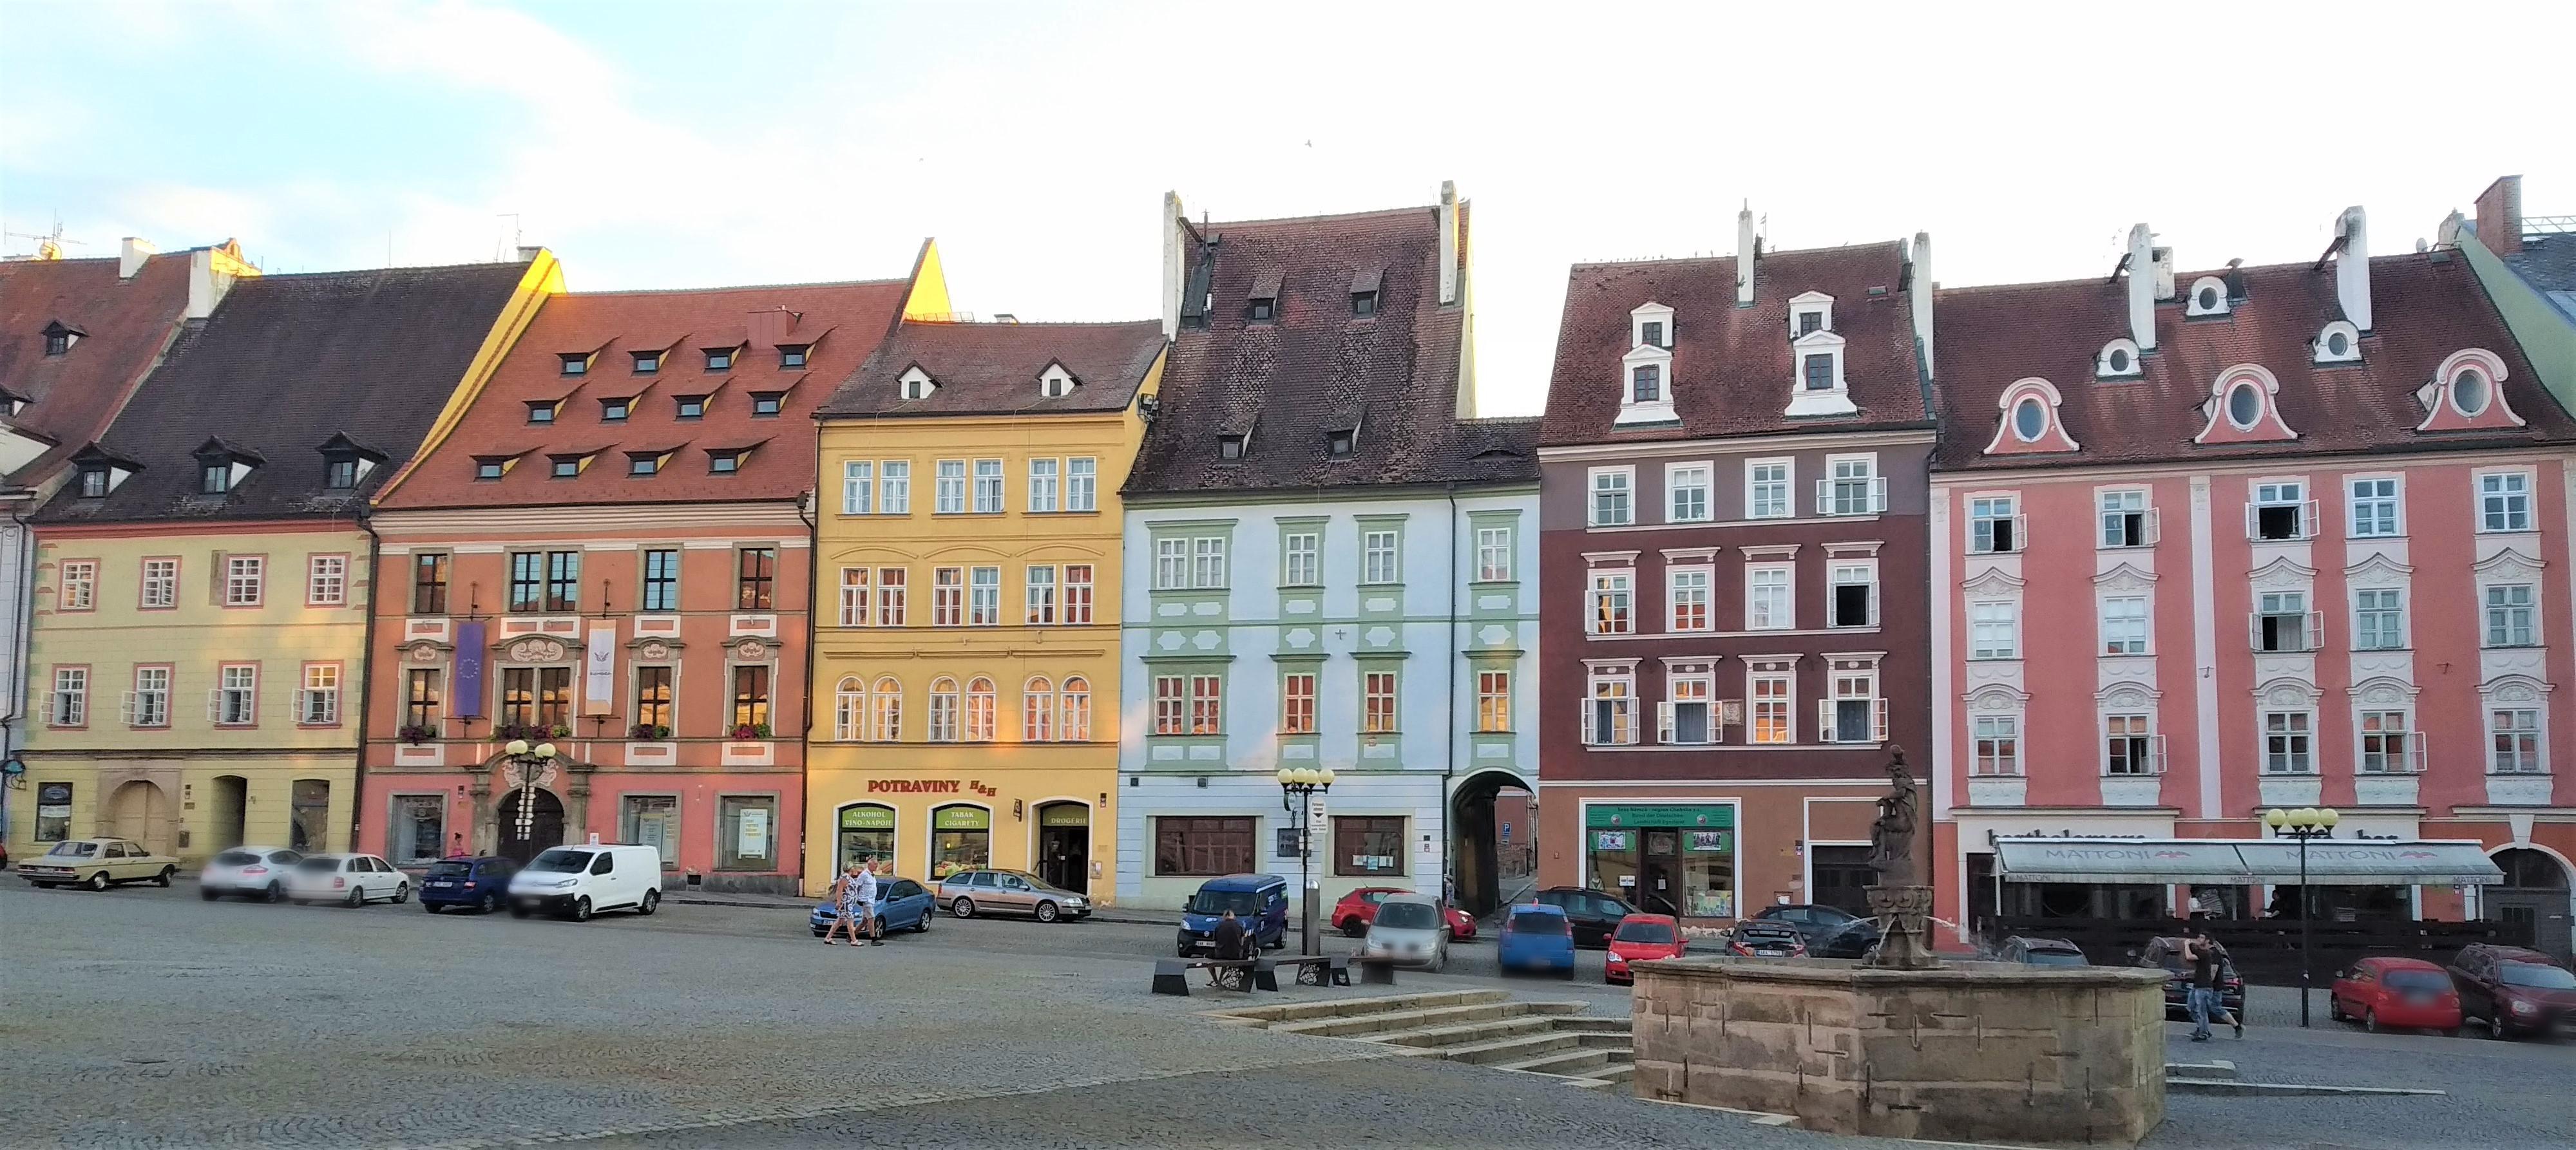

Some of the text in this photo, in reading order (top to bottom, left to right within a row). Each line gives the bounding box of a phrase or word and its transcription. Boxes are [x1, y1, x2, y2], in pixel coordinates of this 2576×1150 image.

[867, 780, 997, 797] POTRAVINY H&H
[1504, 823, 1509, 832] P
[2046, 849, 2150, 860] MATTONI
[2285, 851, 2396, 860] MATTONI
